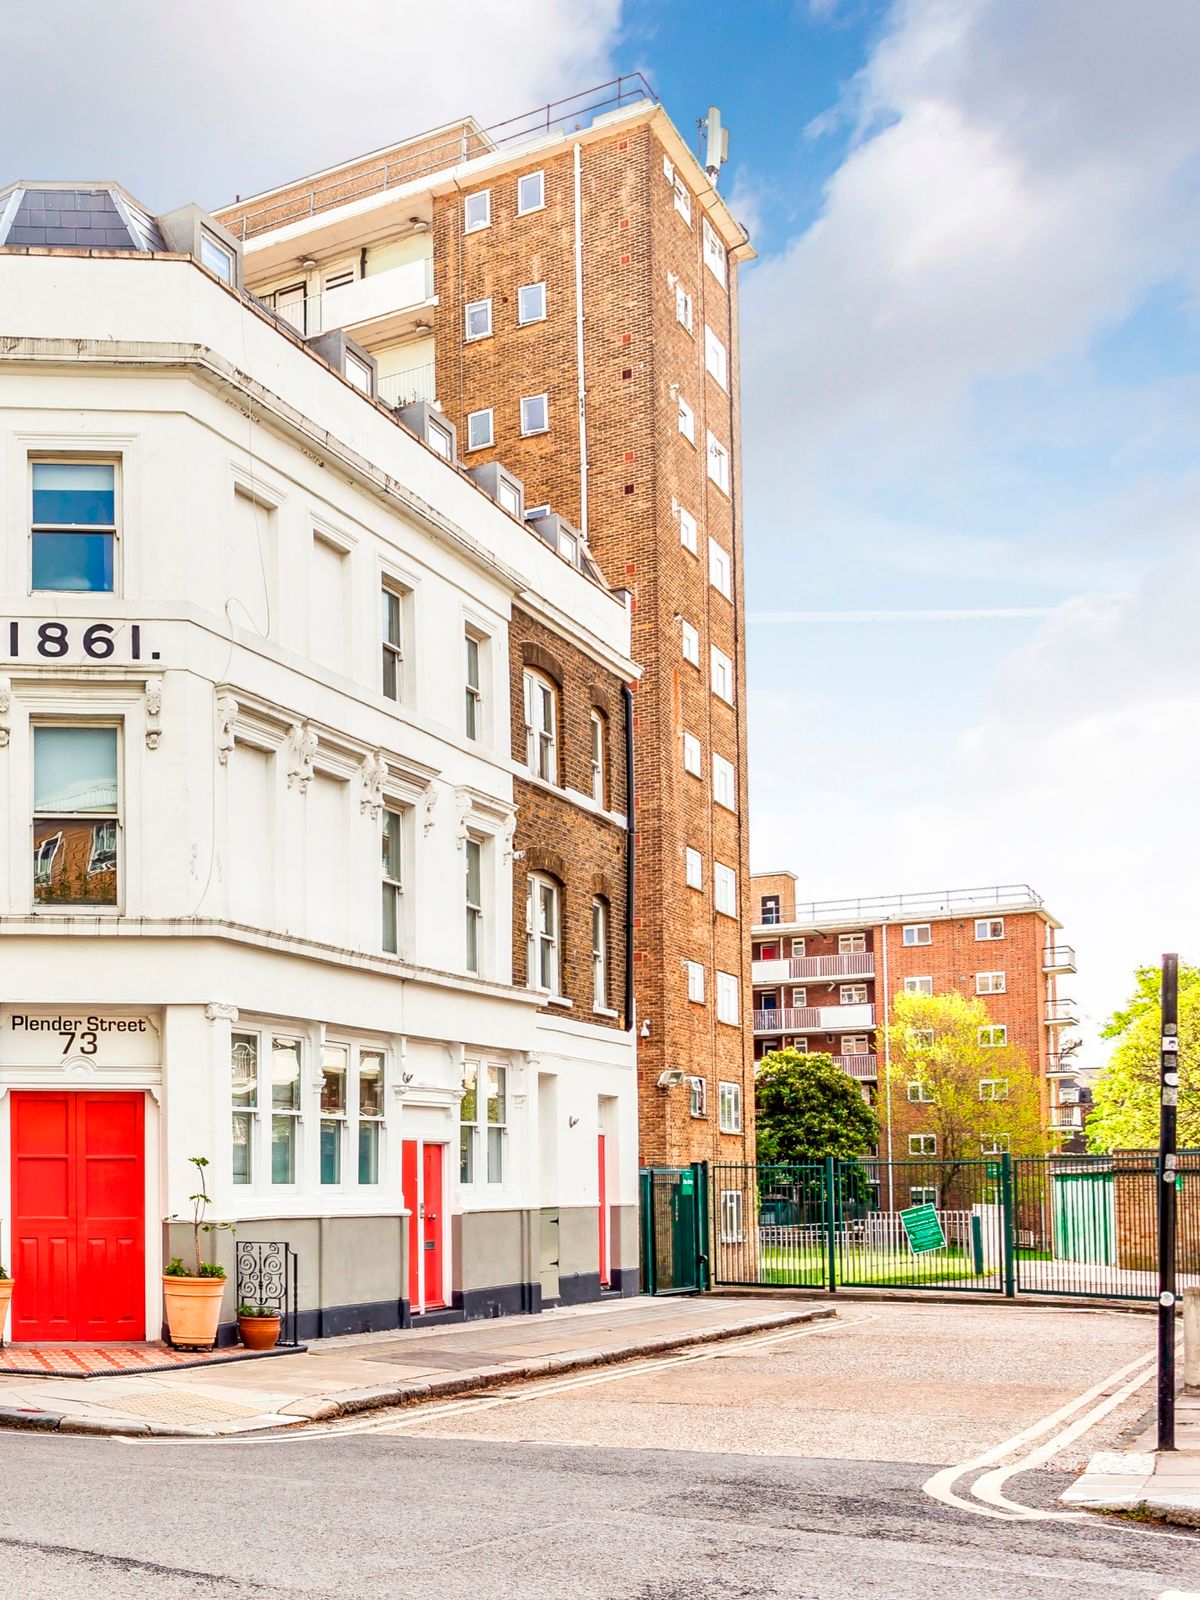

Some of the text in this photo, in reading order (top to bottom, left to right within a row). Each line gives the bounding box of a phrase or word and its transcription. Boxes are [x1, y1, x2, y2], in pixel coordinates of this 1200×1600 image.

[10, 621, 161, 660] 1861.
[11, 1015, 146, 1032] Plender Street
[59, 1032, 98, 1055] 73
